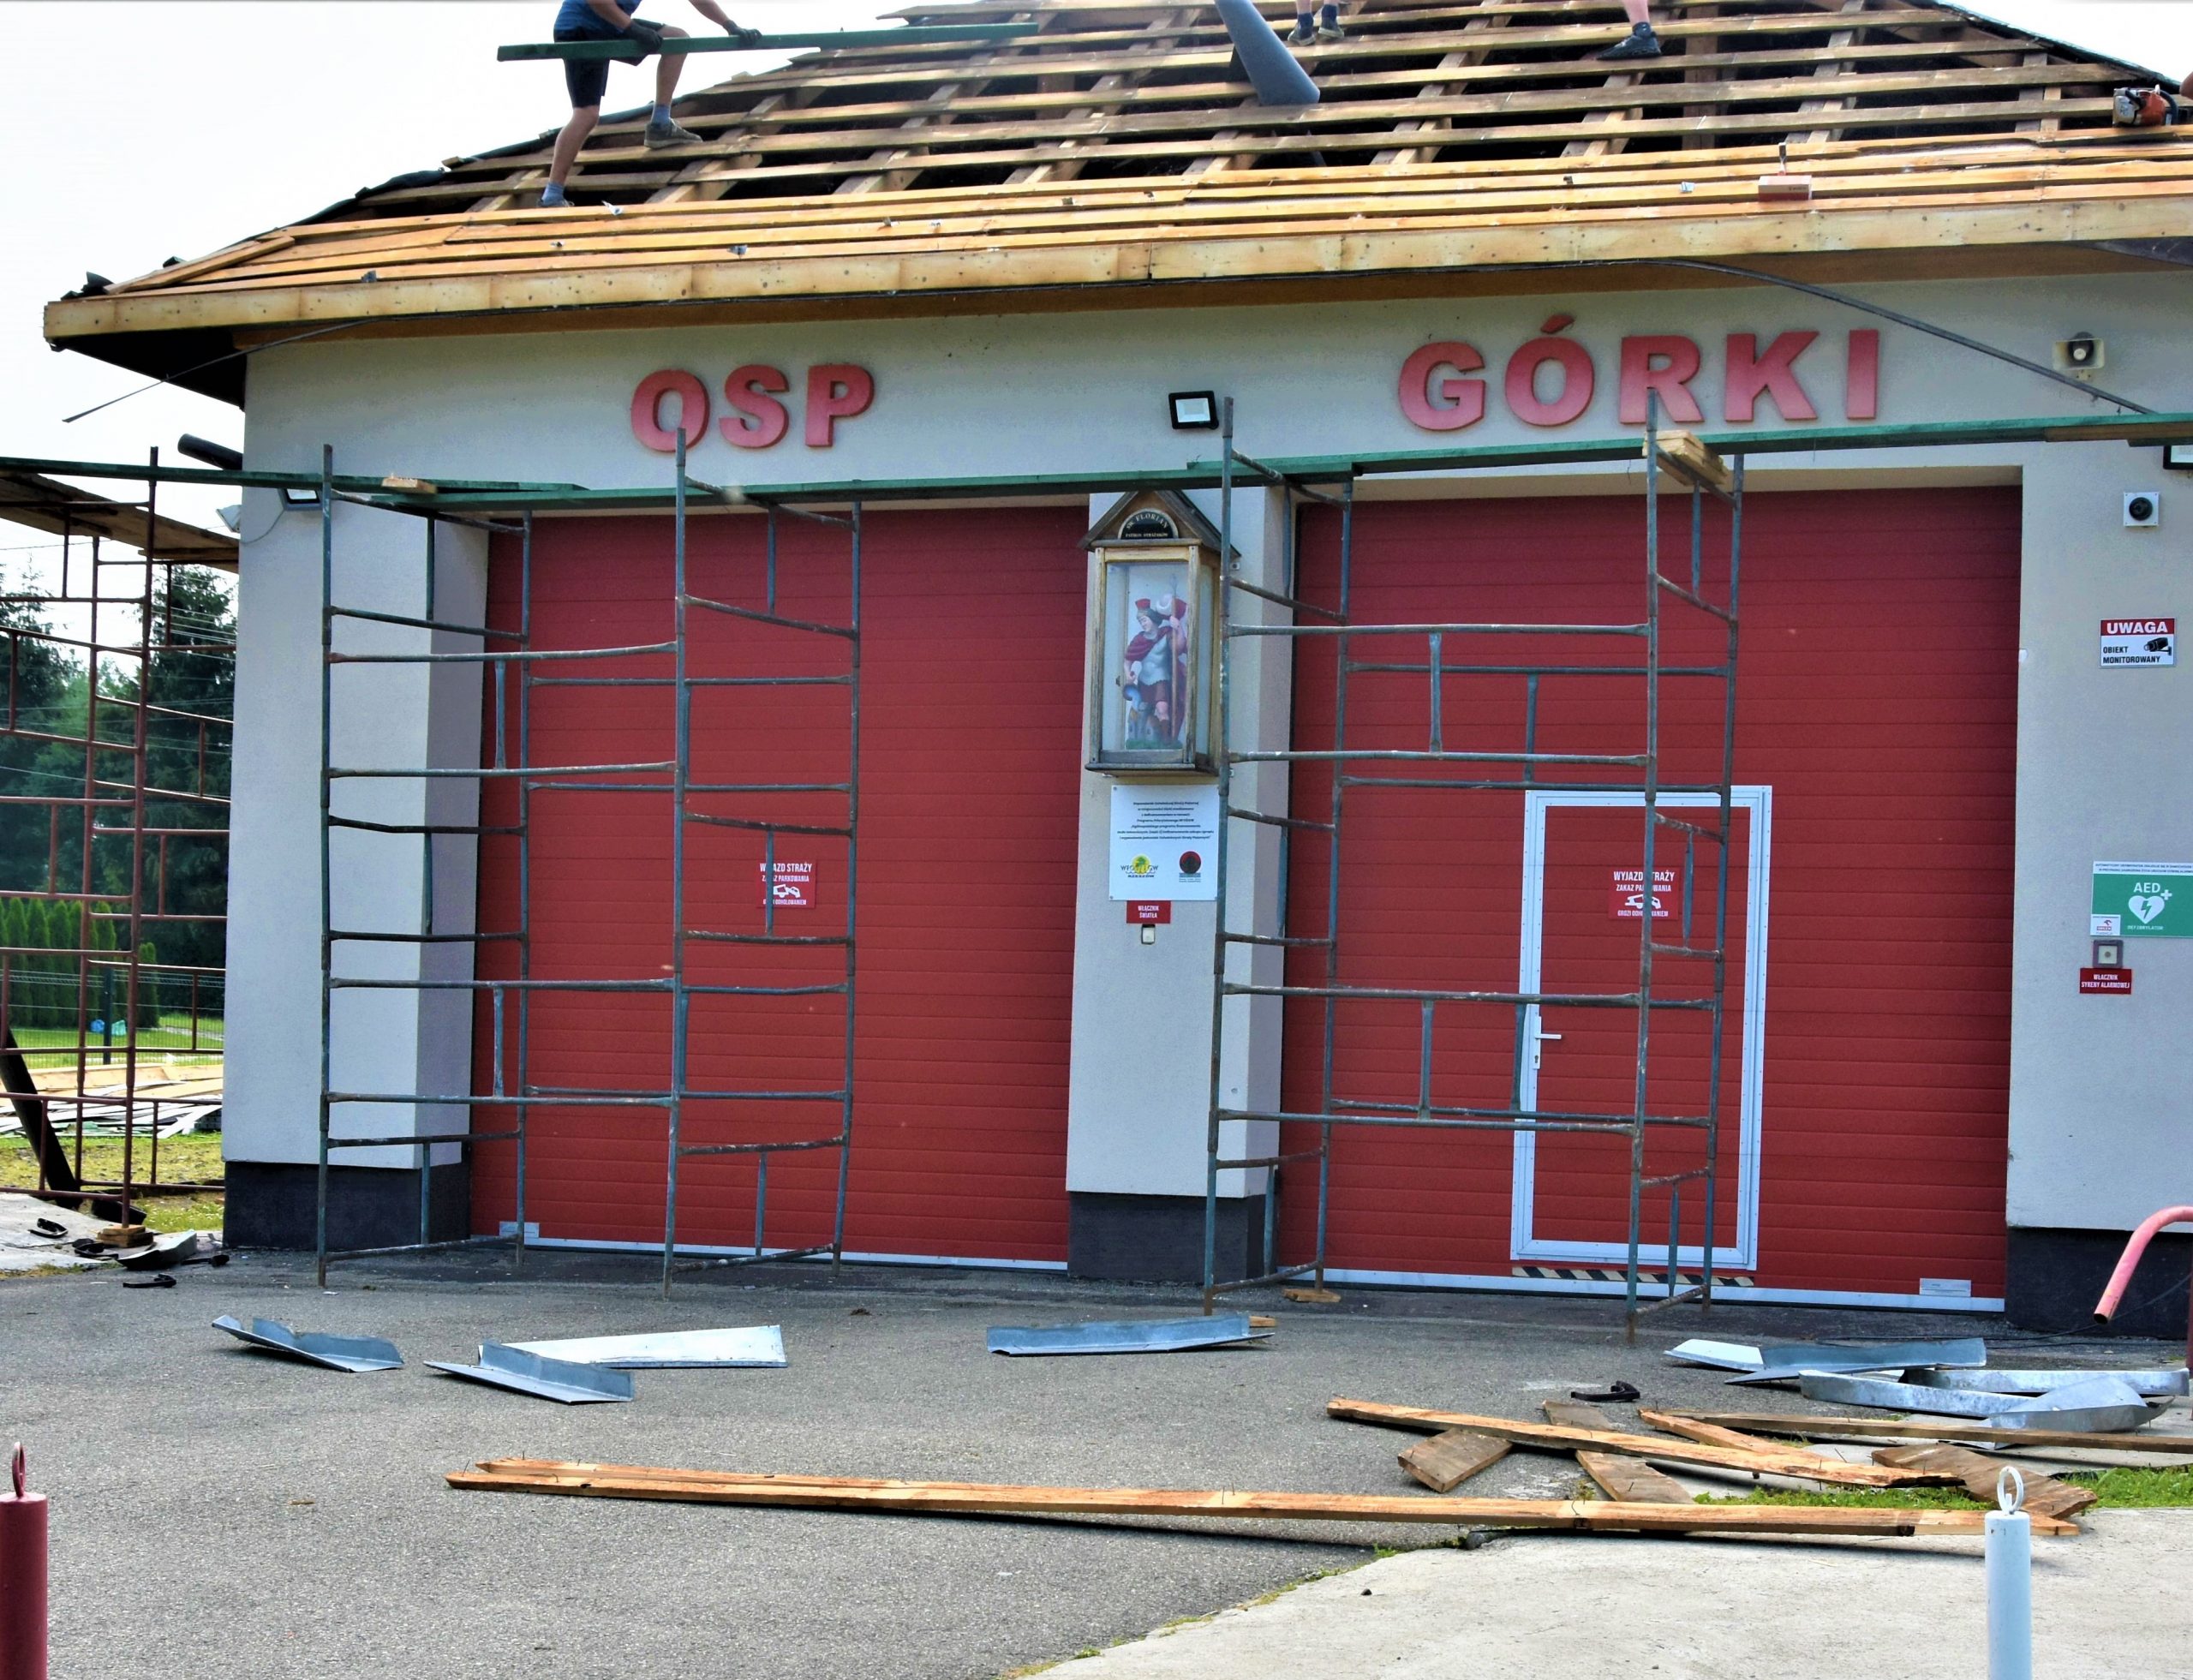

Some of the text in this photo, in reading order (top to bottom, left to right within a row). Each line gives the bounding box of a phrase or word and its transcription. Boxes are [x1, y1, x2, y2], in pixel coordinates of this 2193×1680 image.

[630, 314, 1879, 453] OSP GÓRKI
[2106, 621, 2168, 634] UWAGA
[2102, 655, 2161, 664] MONITOROWANY
[760, 861, 813, 872] WAZD STRAŻY
[1613, 870, 1644, 882] WYJAZD
[2133, 882, 2161, 894] AED
